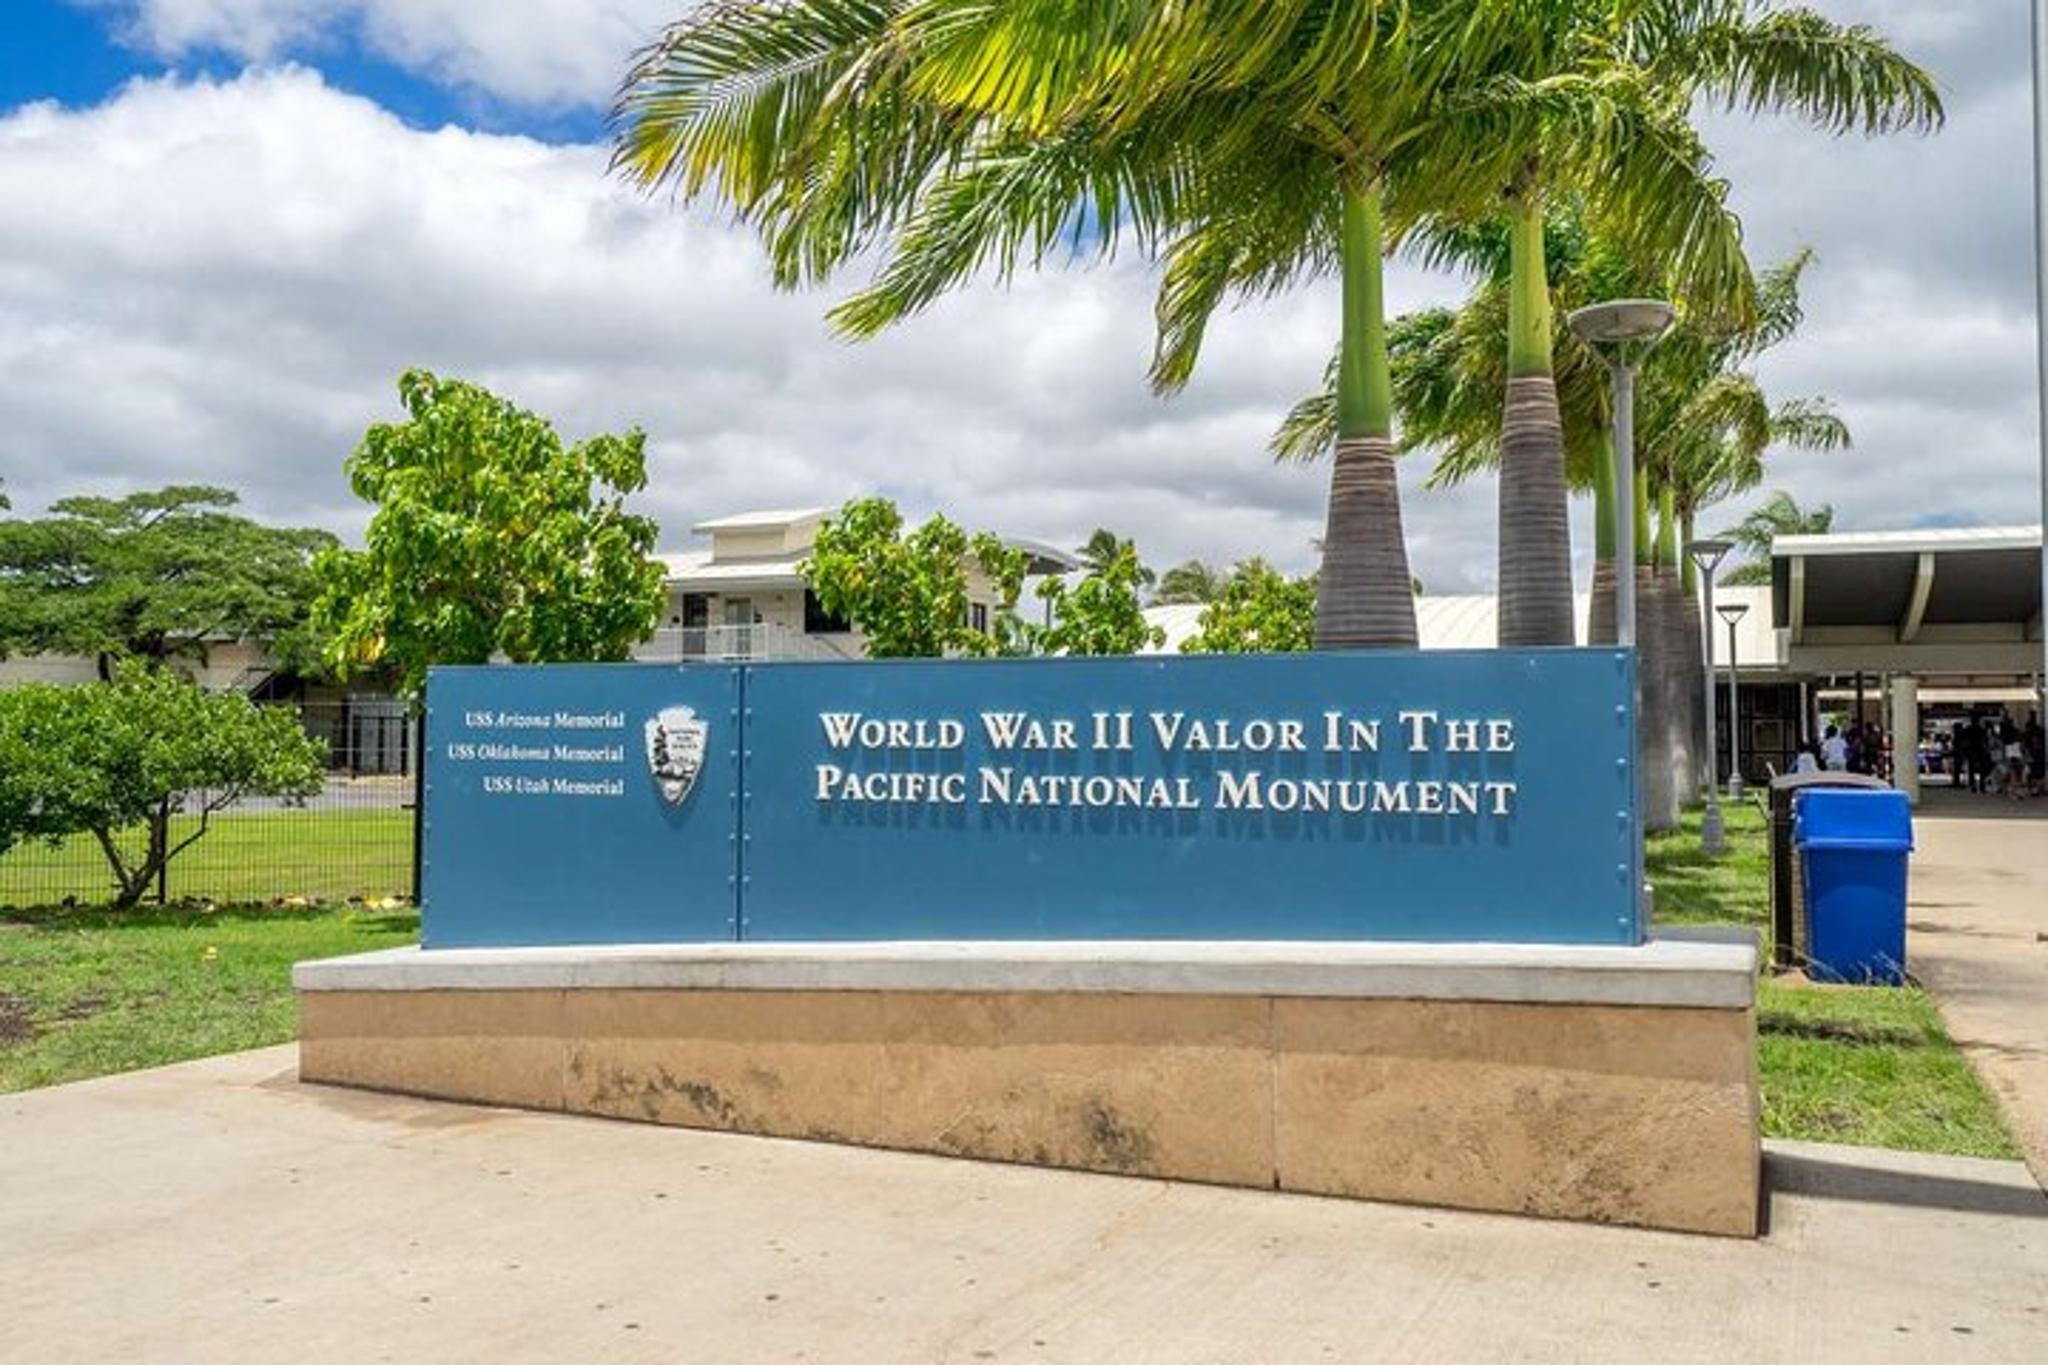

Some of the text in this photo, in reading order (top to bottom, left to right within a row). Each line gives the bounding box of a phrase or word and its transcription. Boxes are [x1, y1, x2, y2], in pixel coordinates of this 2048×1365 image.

[465, 711, 625, 729] USS Arizona Memorial
[819, 709, 1516, 752] WORLD WAR II VALOR IN THE
[448, 744, 625, 762] USS Oklahoma Memorial
[483, 776, 625, 795] USS Utah Memorial
[815, 764, 1516, 815] PACIFIC NATIONAL MONUMENT
